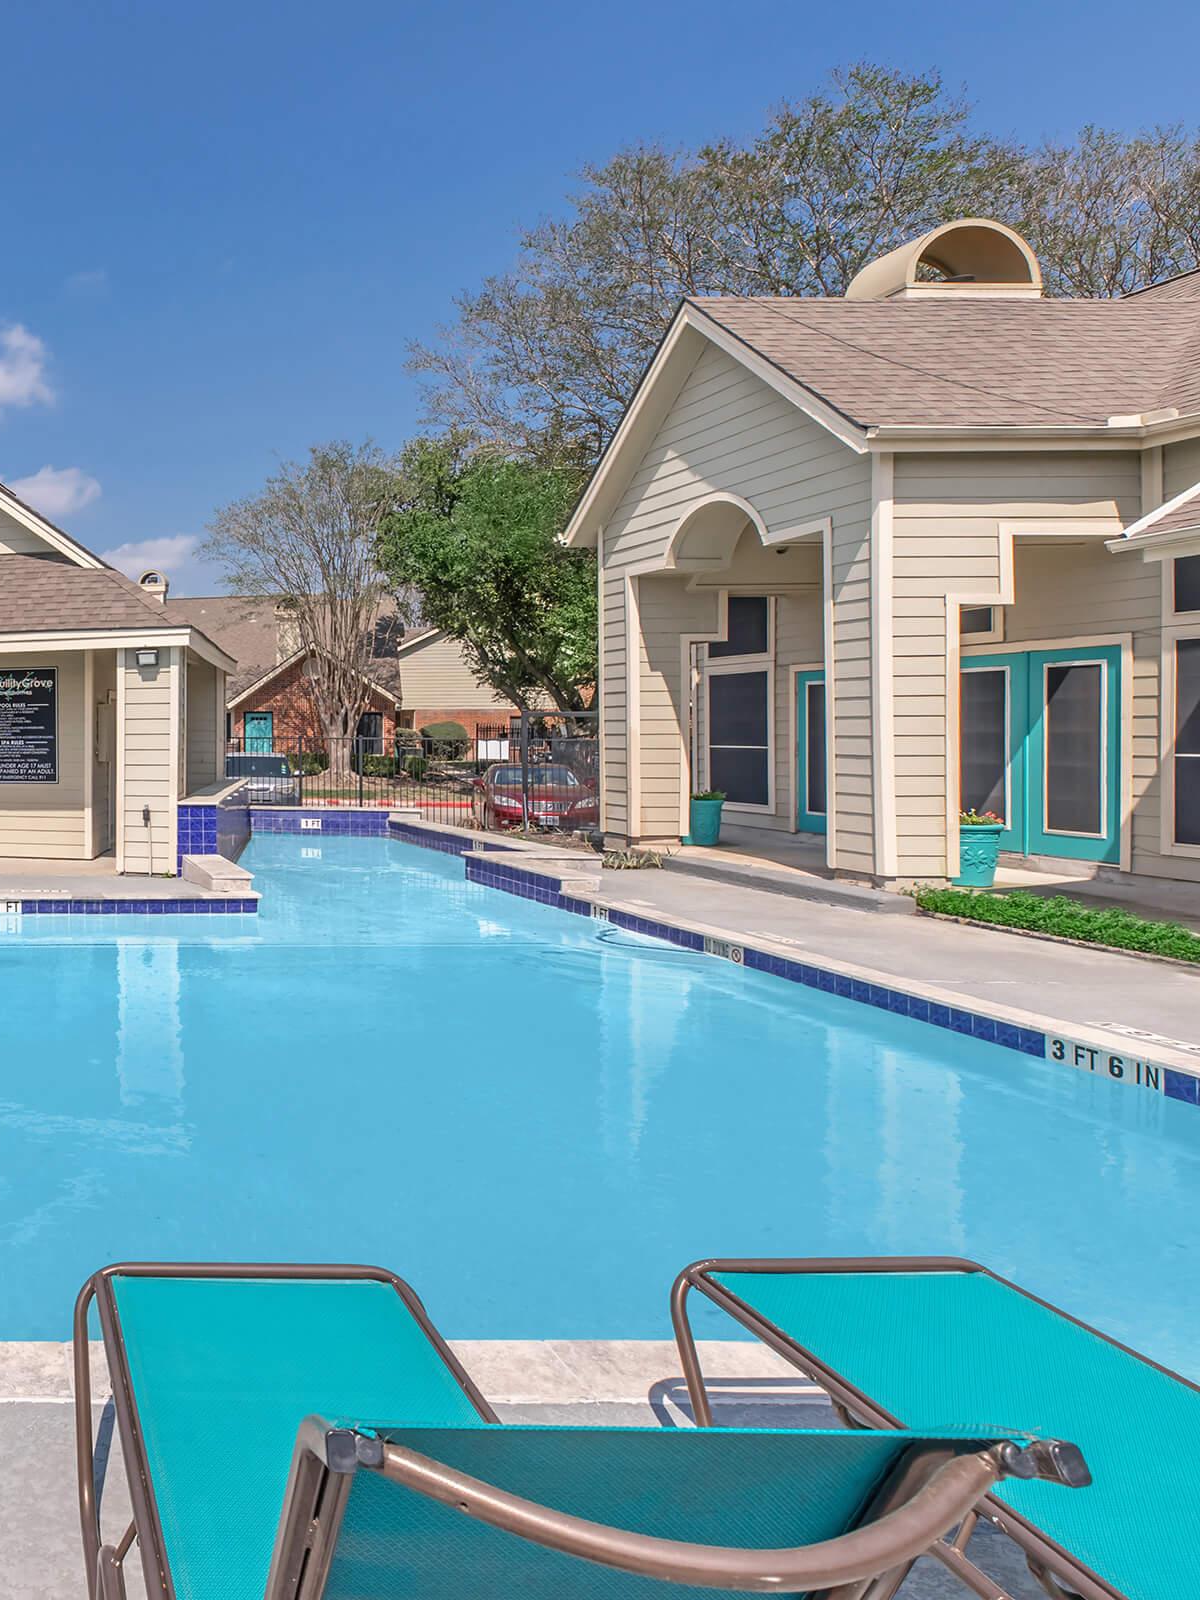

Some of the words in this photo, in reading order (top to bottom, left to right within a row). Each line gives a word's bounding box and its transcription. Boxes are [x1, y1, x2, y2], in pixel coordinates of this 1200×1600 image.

[311, 820, 321, 828] FT
[6, 901, 20, 913] FT
[599, 907, 609, 921] FT
[1052, 1039, 1065, 1061] 3
[1074, 1044, 1099, 1071] FT
[1108, 1055, 1124, 1079] 6
[1136, 1061, 1160, 1091] IN
